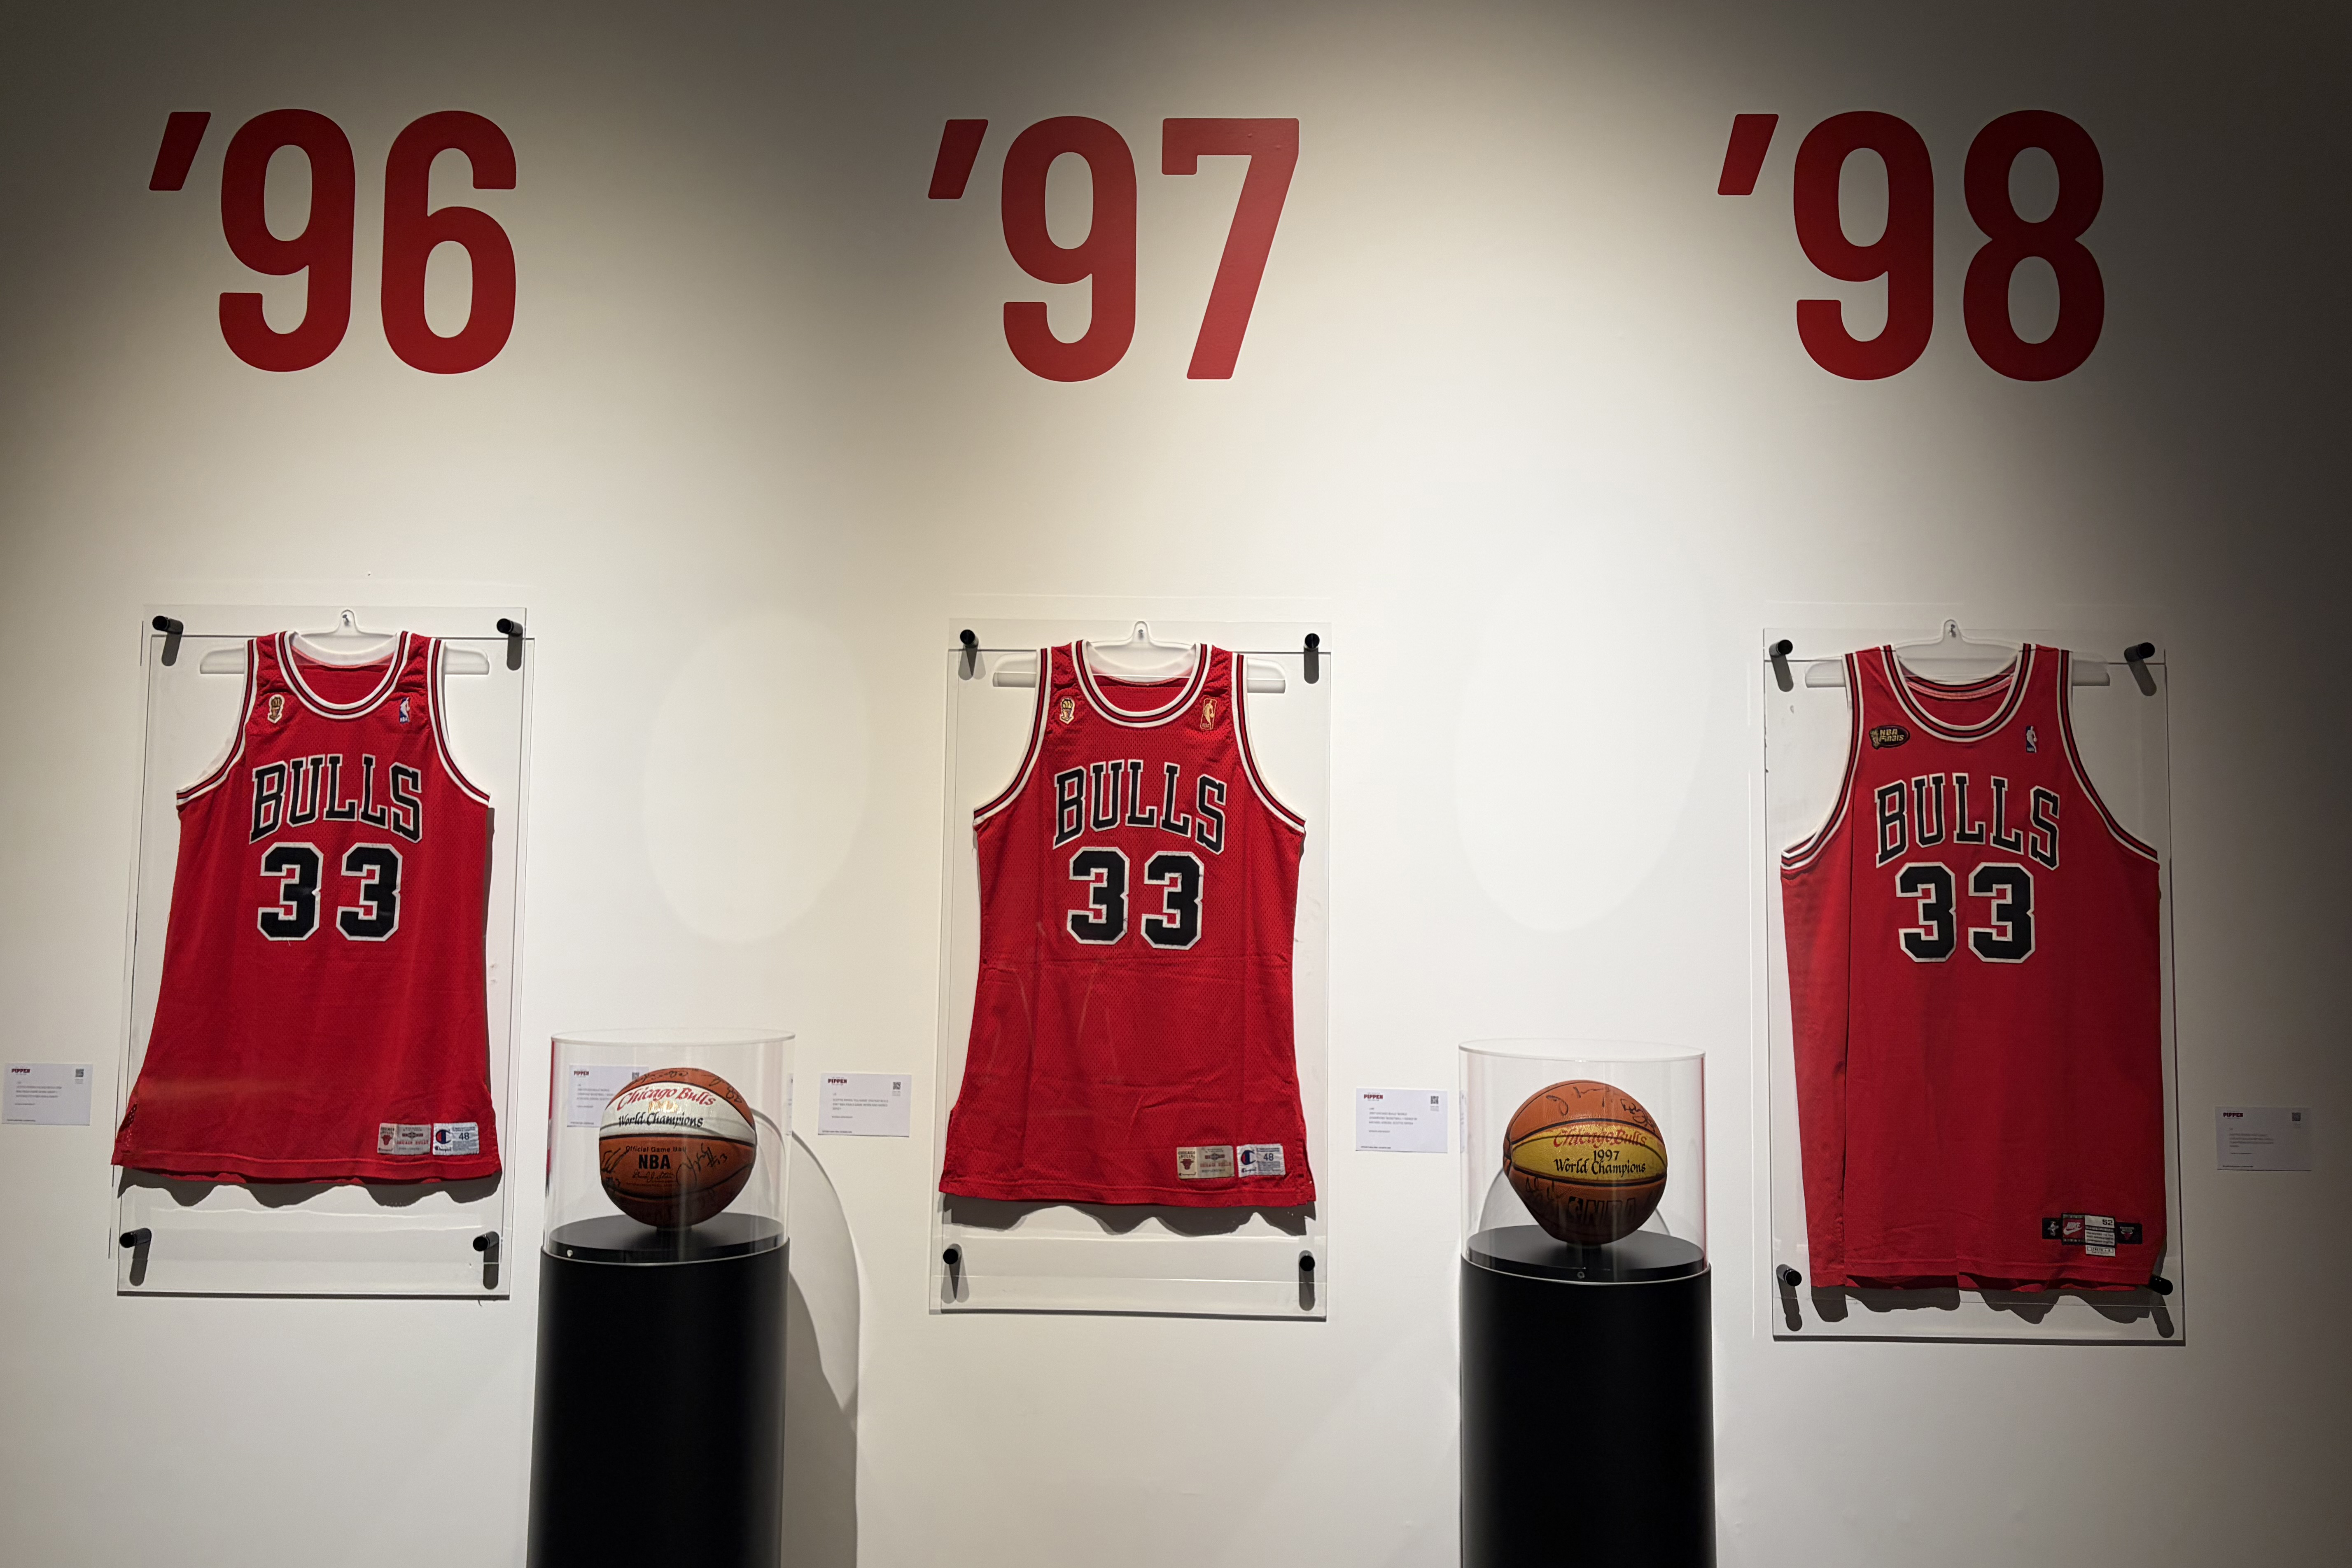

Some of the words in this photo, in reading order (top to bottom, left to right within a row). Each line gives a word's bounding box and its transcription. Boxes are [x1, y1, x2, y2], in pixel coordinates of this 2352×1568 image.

[249, 754, 422, 845] BULLS
[1053, 759, 1227, 855] BULLS
[1874, 772, 2060, 870] BULLS
[257, 842, 403, 941] 33
[1066, 847, 1204, 950] 33
[1895, 862, 2036, 964] 33
[617, 1086, 678, 1111] Chicago
[675, 1087, 716, 1106] Bulls
[619, 1112, 646, 1127] World
[647, 1112, 704, 1129] Champions
[459, 1132, 469, 1140] 48
[1610, 1129, 1647, 1146] Bulls
[639, 1154, 671, 1169] NBA
[1593, 1149, 1620, 1161] 1997
[1554, 1158, 1589, 1174] World
[1591, 1160, 1646, 1178] Champions
